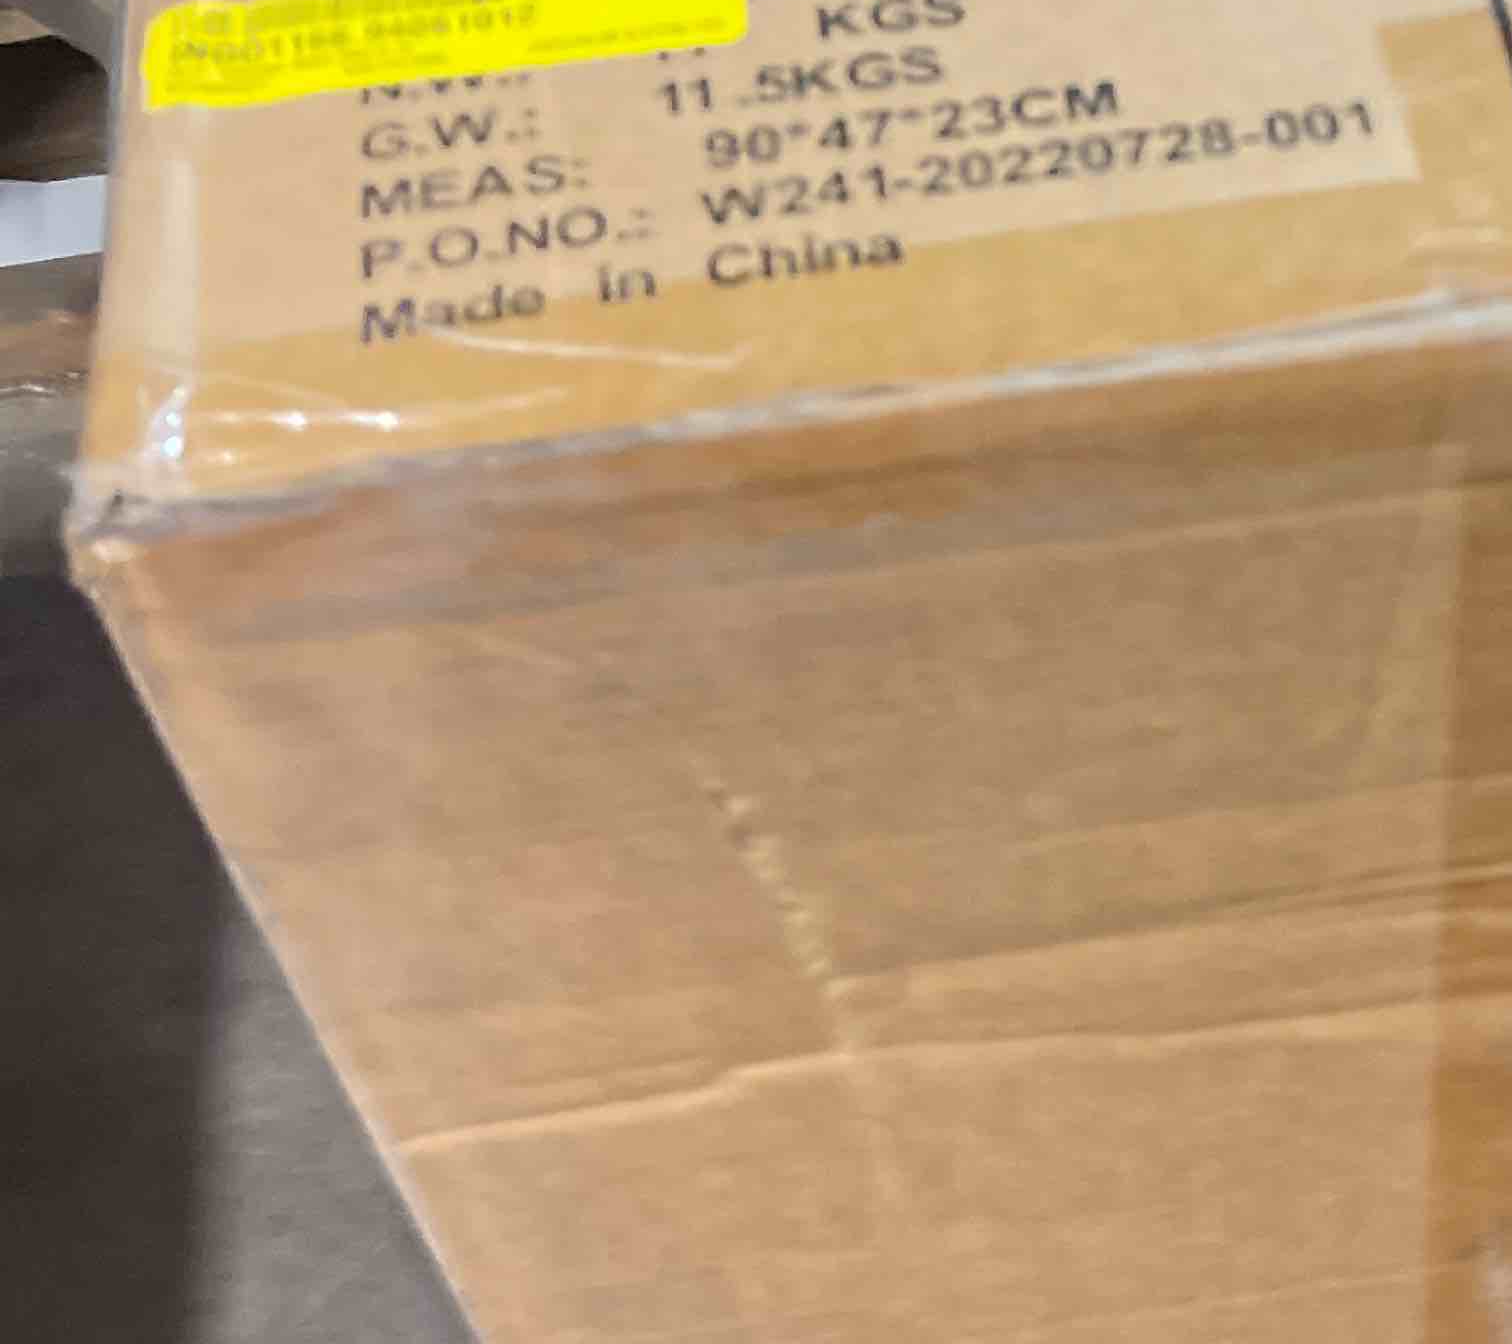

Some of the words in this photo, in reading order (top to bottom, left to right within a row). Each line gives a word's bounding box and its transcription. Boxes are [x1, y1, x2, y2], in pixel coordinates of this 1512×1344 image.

[360, 156, 590, 219] MEAS:
[701, 100, 1376, 225] W241-20220728-001
[360, 286, 546, 346] Made
[599, 261, 656, 303] in
[706, 232, 904, 288] China
